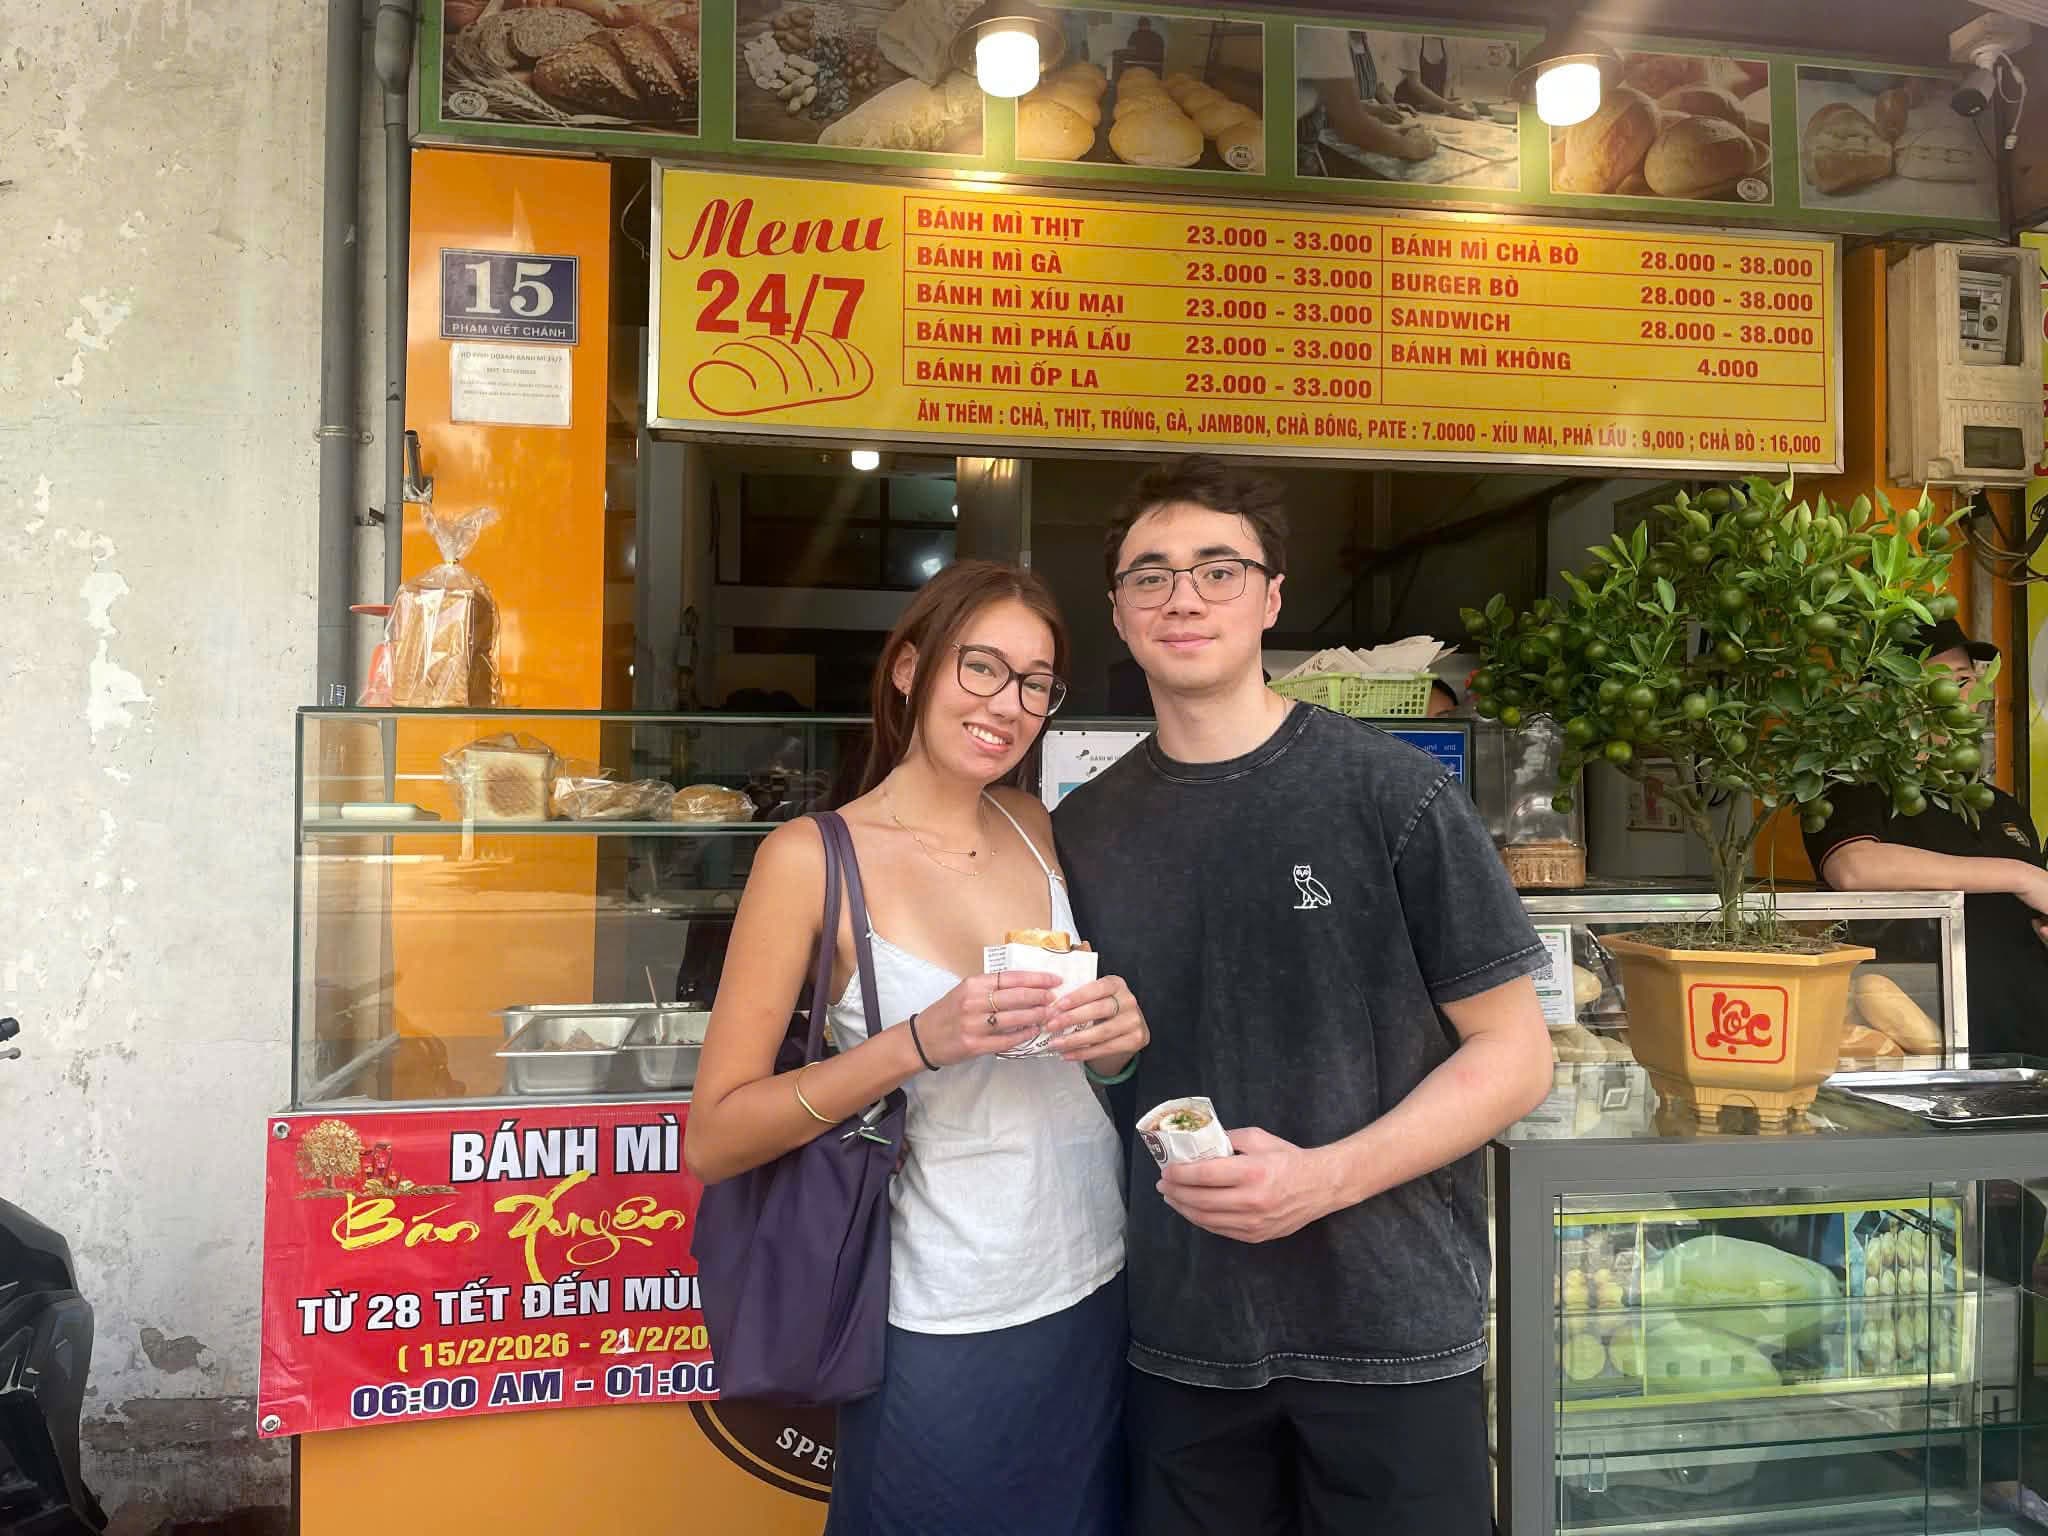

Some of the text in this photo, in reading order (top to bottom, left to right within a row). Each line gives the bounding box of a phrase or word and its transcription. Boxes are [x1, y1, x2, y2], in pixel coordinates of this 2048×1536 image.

[668, 198, 892, 260] Menu
[918, 205, 1084, 241] BÁNH MÌ THỊT
[1186, 225, 1267, 248] 23.000
[1294, 231, 1372, 253] 33.000
[1391, 233, 1451, 257] BÁNH
[1461, 237, 1487, 260] MÌ
[1550, 243, 1578, 265] BÒ
[917, 243, 1062, 274] BÁNH MÌ GÀ
[1641, 251, 1715, 272] 28.000
[1740, 256, 1812, 277] 38.000
[465, 260, 554, 317] 15
[1186, 262, 1267, 284] 23.000
[1294, 267, 1372, 289] 33.000
[1391, 272, 1519, 298] BURGER BÒ
[695, 268, 865, 345] 24/7
[917, 280, 1124, 317] BÁNH MÌ XÍU MẠI
[1185, 298, 1267, 319] 23.000
[1294, 303, 1372, 324] 33.000
[1641, 286, 1715, 307] 28.000
[1740, 291, 1812, 312] 38.000
[916, 318, 1131, 352] BÁNH MÌ PHÁ LẤU
[1391, 307, 1510, 332] SANDWICH
[1640, 321, 1715, 341] 28.000
[1740, 325, 1813, 345] 38.000
[1185, 335, 1267, 356] 23.000
[1293, 340, 1372, 361] 33.000
[1391, 340, 1571, 370] BÁNH MÌ KHÔNG
[916, 357, 1098, 388] BÁNH MÌ ỐP LA
[1697, 359, 1758, 378] 4.000
[1185, 374, 1267, 394] 23.000
[1293, 378, 1372, 399] 33.000
[917, 398, 940, 422] ĂN
[946, 400, 993, 424] THÊM
[1368, 420, 1406, 439] PATE
[1422, 422, 1475, 441] 7.0000
[1492, 421, 1518, 444] XÍU
[1563, 424, 1593, 446] PHÁ
[1642, 430, 1684, 451] 9,000
[1735, 428, 1755, 451] BÒ
[1770, 434, 1821, 455] 16,000
[450, 1114, 680, 1183] BÁNH MÌ
[298, 1288, 358, 1335] TỪ
[366, 1292, 422, 1330] 28
[434, 1276, 510, 1325] TẾT
[521, 1269, 610, 1318] ĐẾN
[419, 1332, 570, 1369] 15/2/2026
[600, 1325, 711, 1355] 21/2/20
[350, 1377, 478, 1420] 06:00
[490, 1369, 562, 1404] AM
[776, 1427, 835, 1473] SPE
